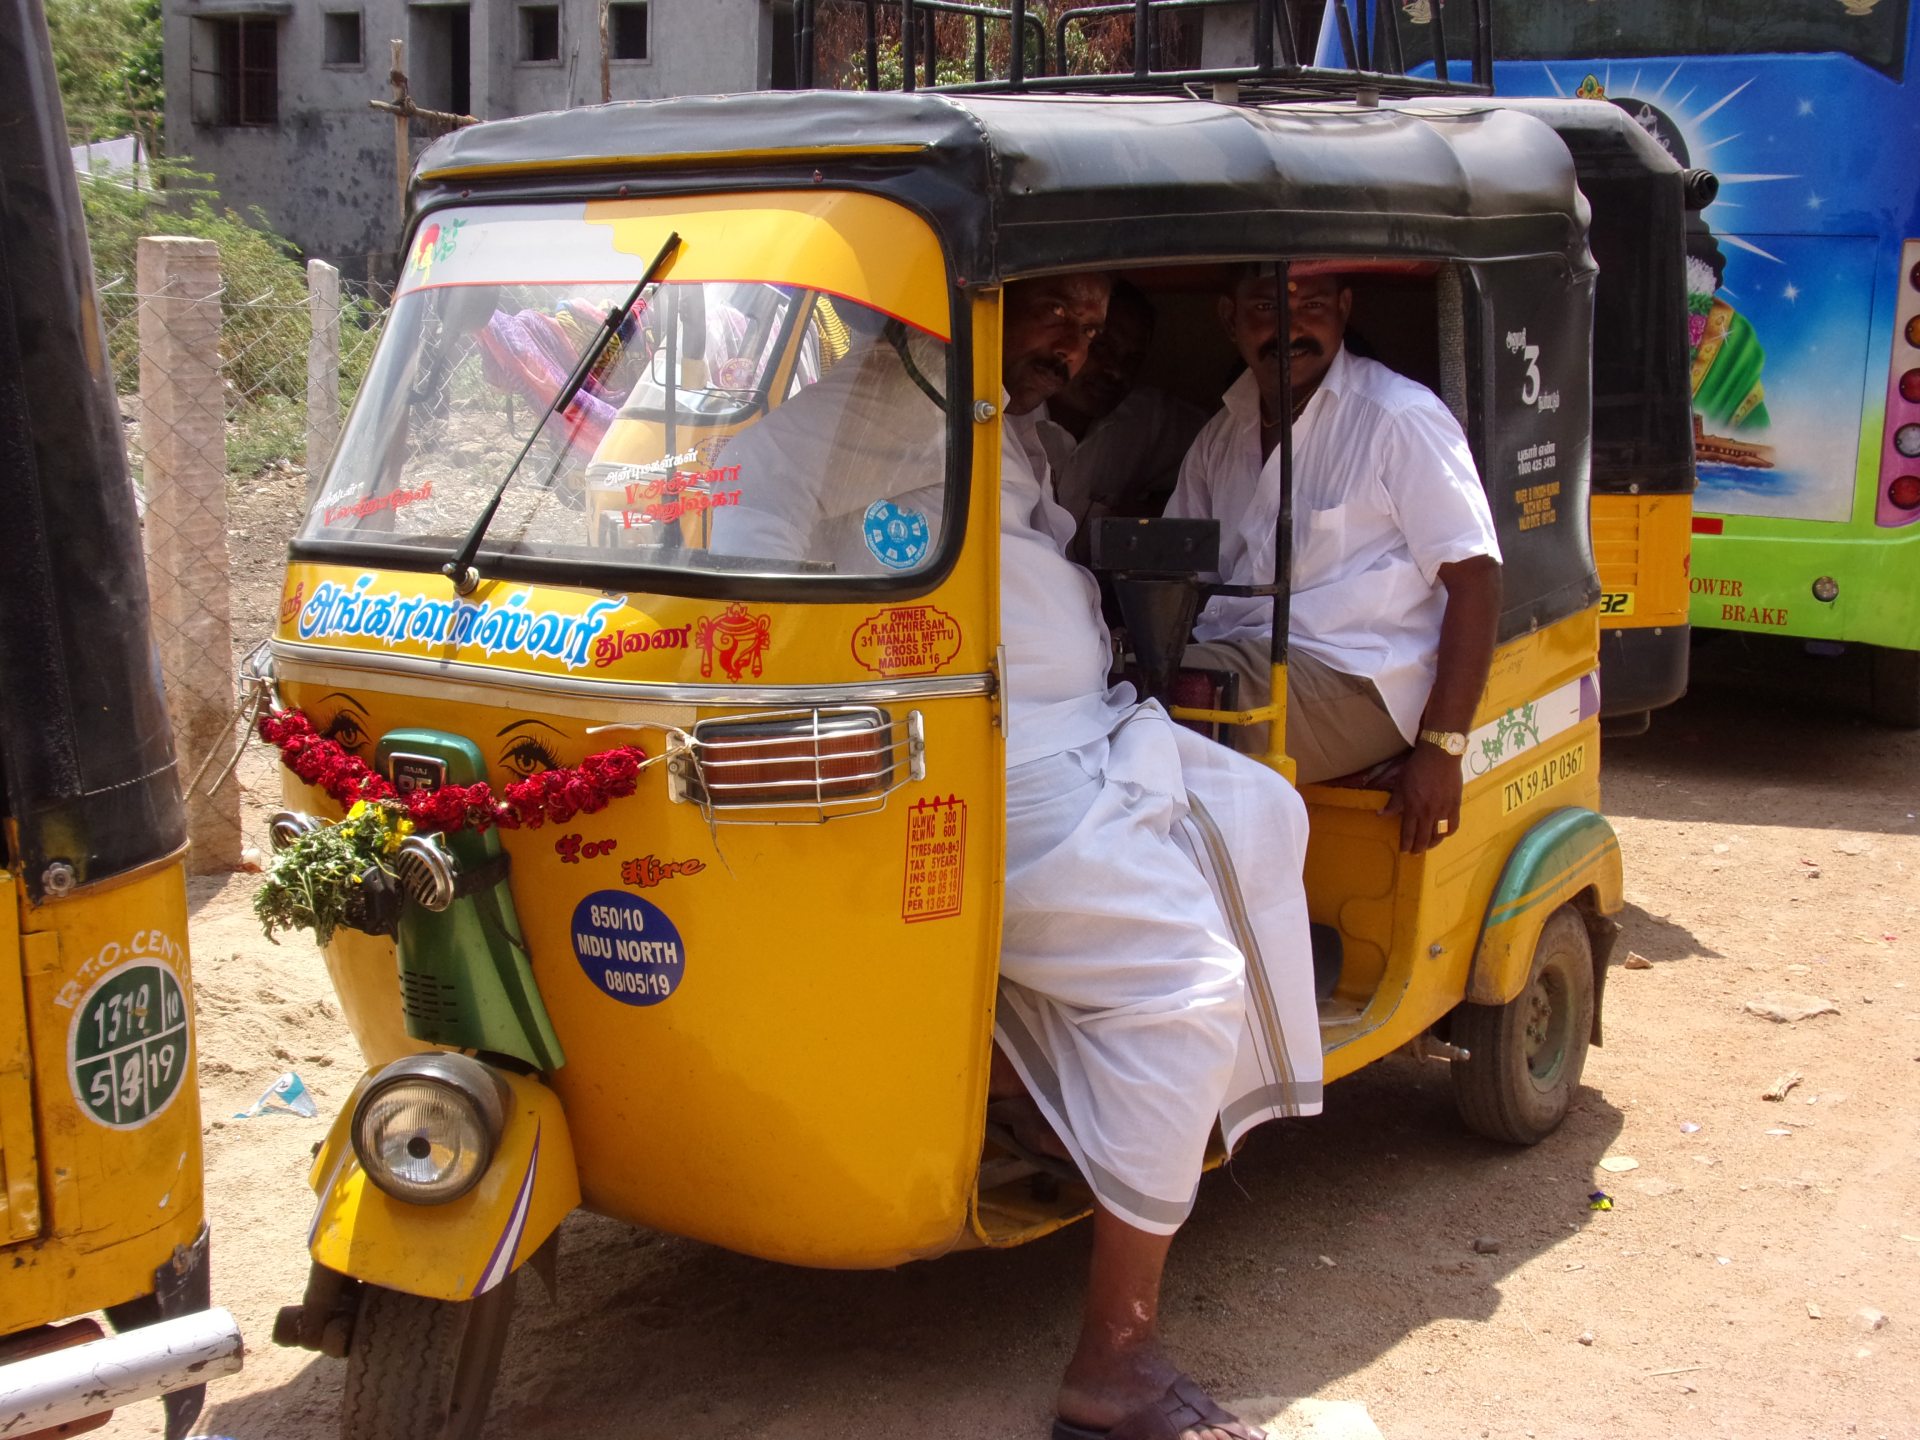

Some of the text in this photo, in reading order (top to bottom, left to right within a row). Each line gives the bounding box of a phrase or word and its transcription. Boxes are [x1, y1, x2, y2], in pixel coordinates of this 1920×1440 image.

[1522, 345, 1540, 405] 3
[1689, 577, 1743, 597] OWER
[890, 609, 927, 622] OWNER
[1721, 604, 1788, 626] BRAKE
[871, 619, 945, 635] R.KATHIRESAN
[595, 624, 692, 668] துணை
[861, 629, 954, 647] 31 MANJAL METTU
[885, 642, 934, 656] CROSS ST
[879, 653, 940, 668] MADURAI 16
[1505, 745, 1583, 812] TN 59 AP 0367
[943, 811, 957, 824] 300
[943, 824, 956, 837] 600
[555, 834, 617, 864] For
[911, 843, 931, 857] TYRES
[621, 854, 706, 888] Hire
[910, 859, 926, 870] TAX
[910, 871, 926, 884] INS
[909, 886, 921, 898] FC
[908, 899, 923, 912] PER
[590, 904, 644, 932] 850/10
[577, 933, 678, 964] MDU NORTH
[605, 969, 670, 995] 08/05/19
[166, 990, 179, 1024] 10
[90, 1069, 112, 1107] 5
[149, 1044, 175, 1088] 19
